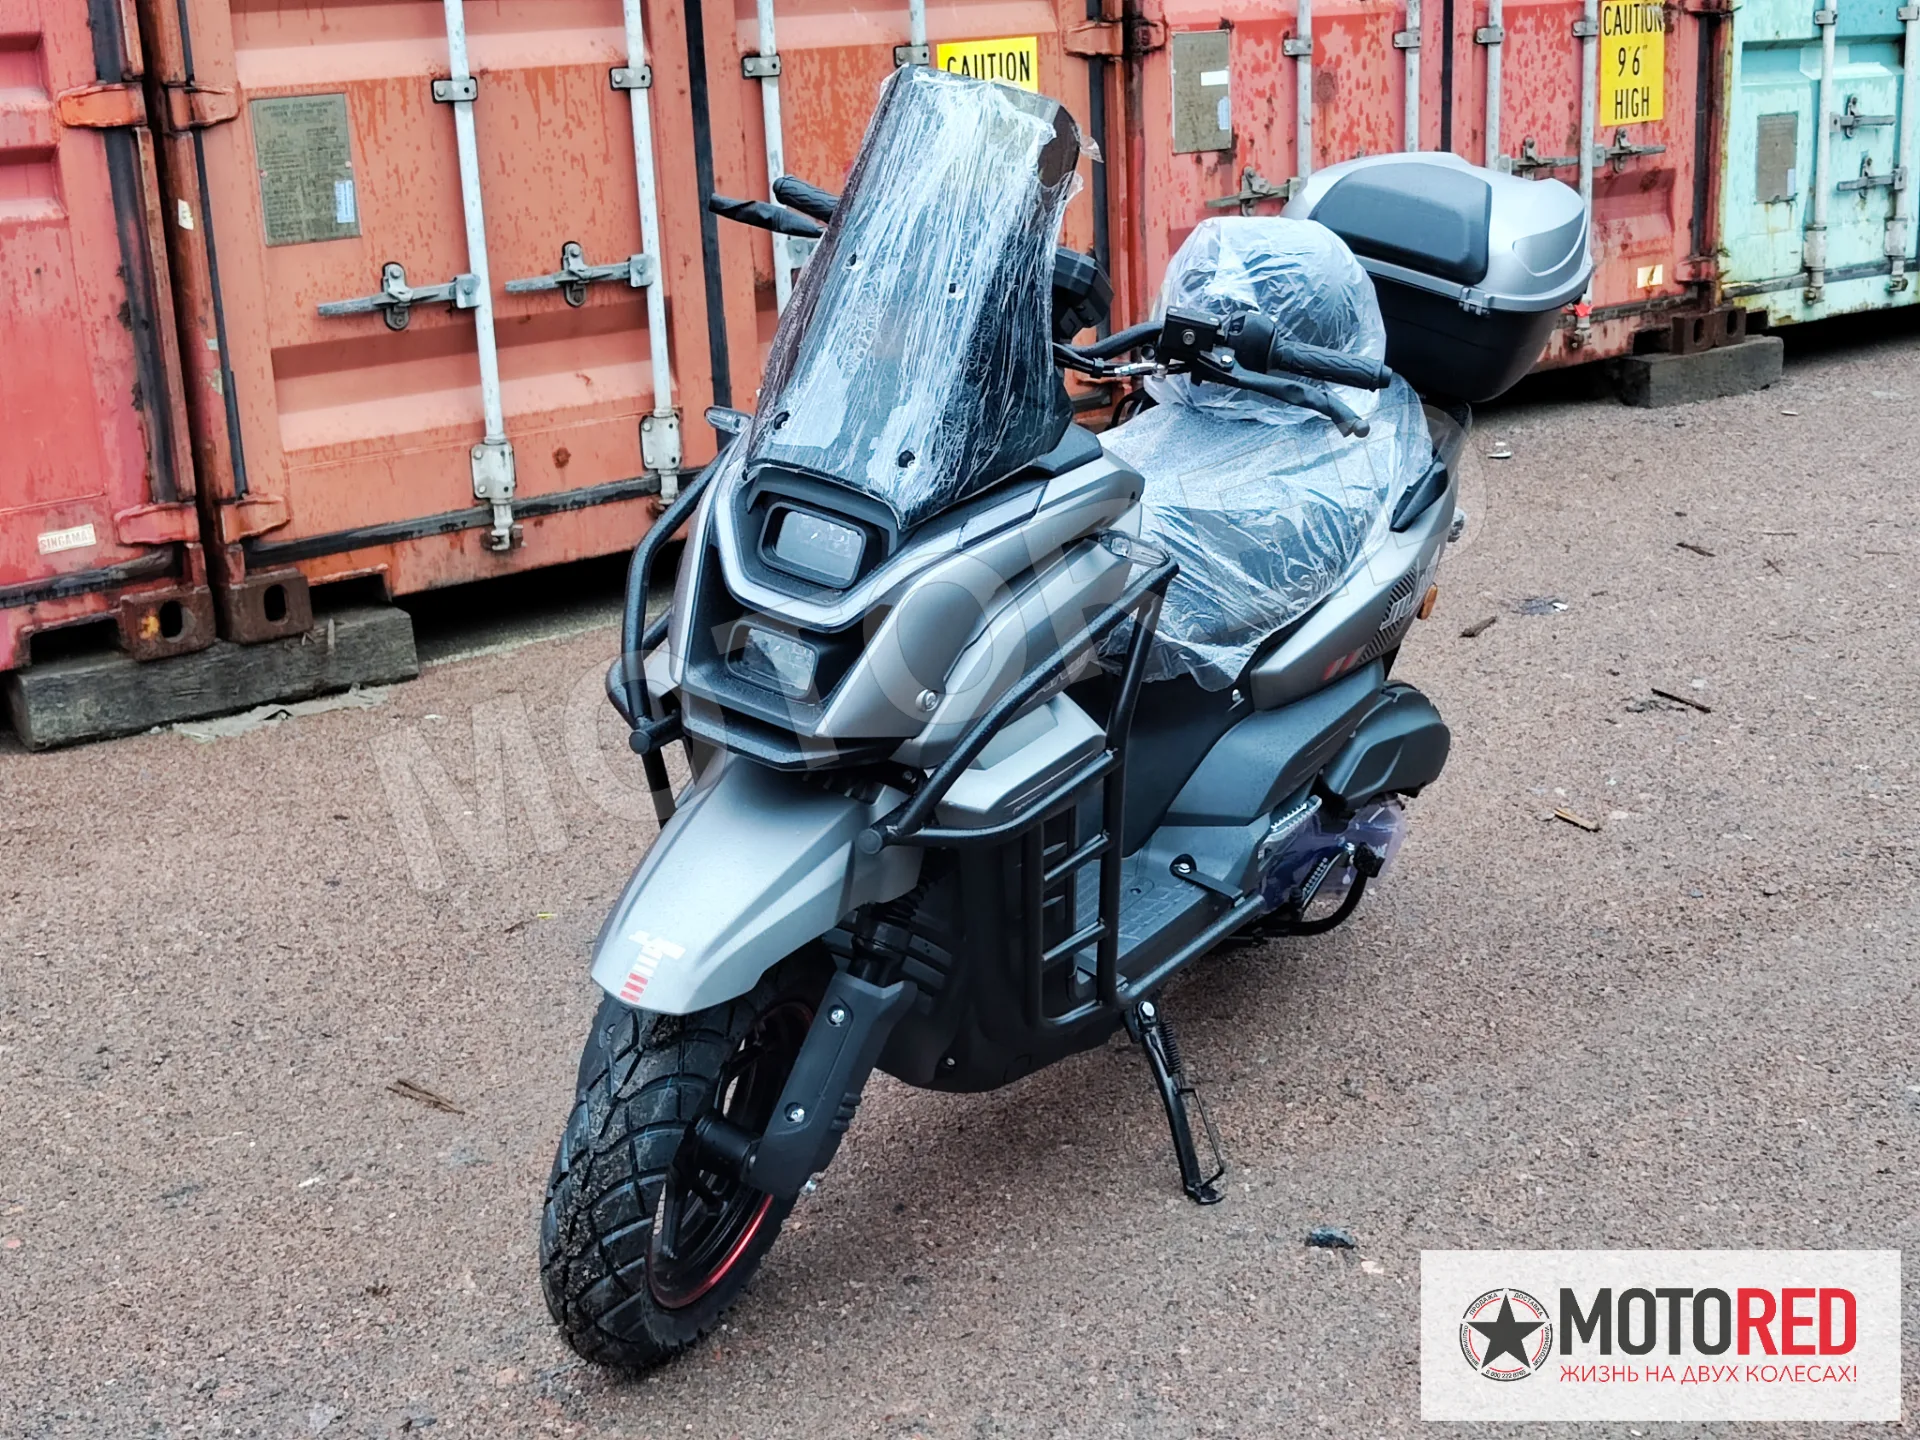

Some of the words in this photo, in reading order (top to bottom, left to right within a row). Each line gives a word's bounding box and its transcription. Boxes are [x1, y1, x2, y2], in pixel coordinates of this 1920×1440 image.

[1603, 3, 1662, 36] CAUTION
[1614, 86, 1650, 120] HIGH
[40, 529, 93, 551] SINGAMA
